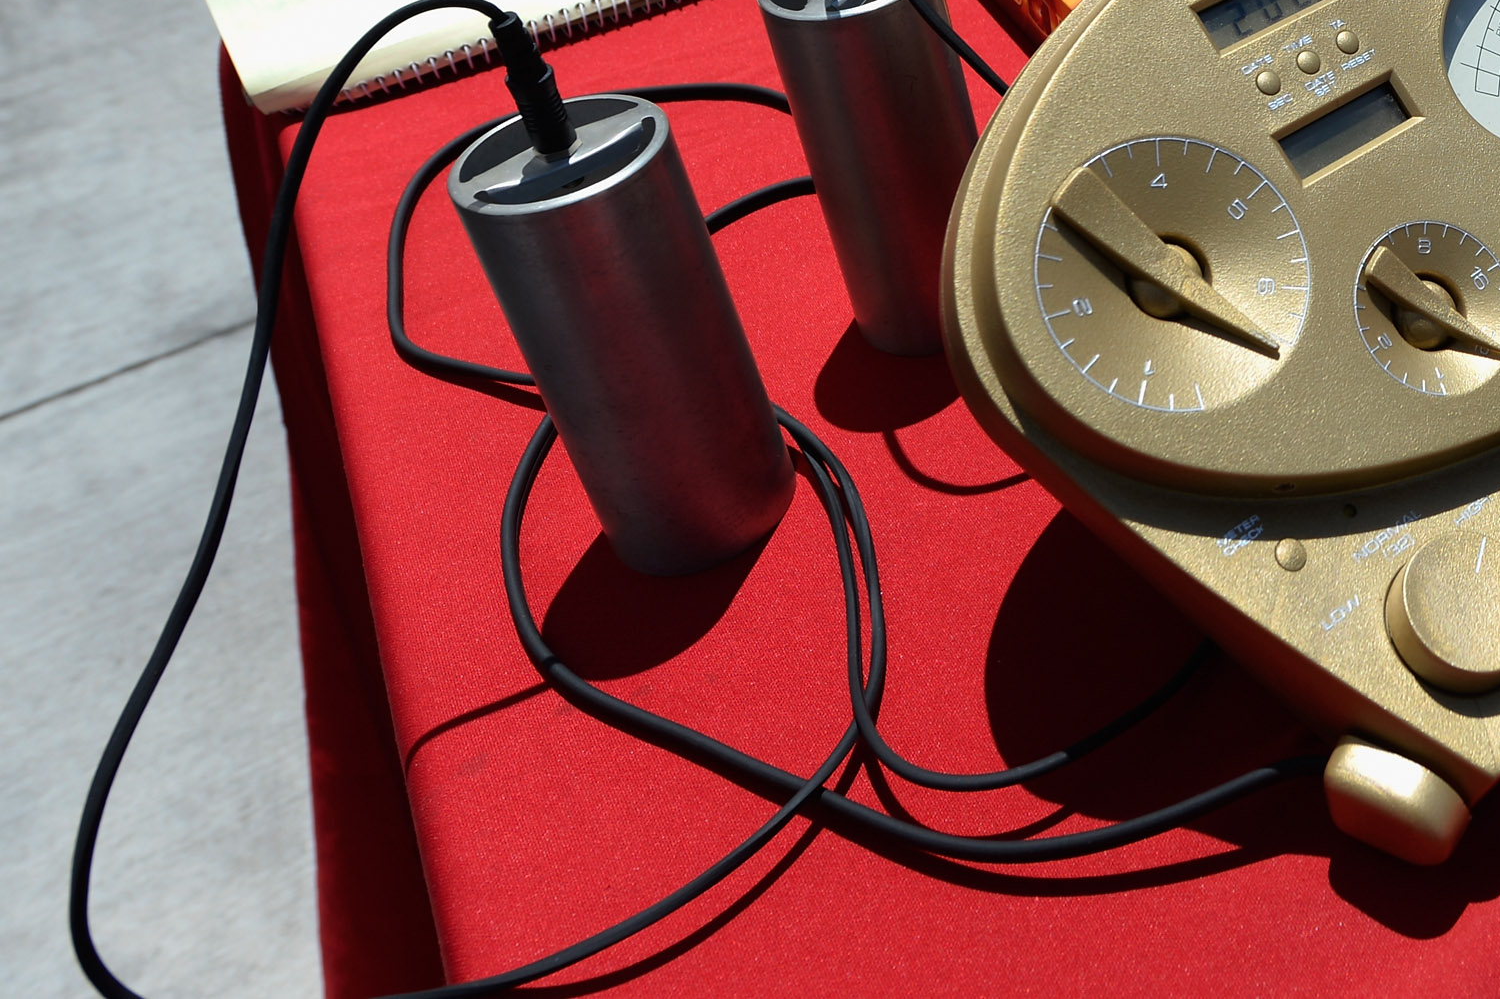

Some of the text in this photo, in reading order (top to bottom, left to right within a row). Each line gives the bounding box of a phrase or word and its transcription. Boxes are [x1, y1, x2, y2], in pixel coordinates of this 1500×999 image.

[1329, 18, 1347, 31] TA
[1282, 34, 1313, 54] TIME
[1240, 54, 1274, 76] DATE
[1340, 49, 1377, 72] RESET
[1304, 70, 1336, 93] DATE
[1313, 81, 1338, 98] SET
[1267, 92, 1294, 112] SEC
[1150, 173, 1168, 189] 4
[1418, 238, 1432, 255] 8
[1470, 266, 1491, 291] 16
[1453, 494, 1493, 526] HIGH
[1216, 514, 1261, 549] METER
[1222, 523, 1265, 558] CHECK
[1352, 509, 1422, 563] NORMAL
[1382, 533, 1416, 562] (32)
[1321, 594, 1361, 632] LOW
